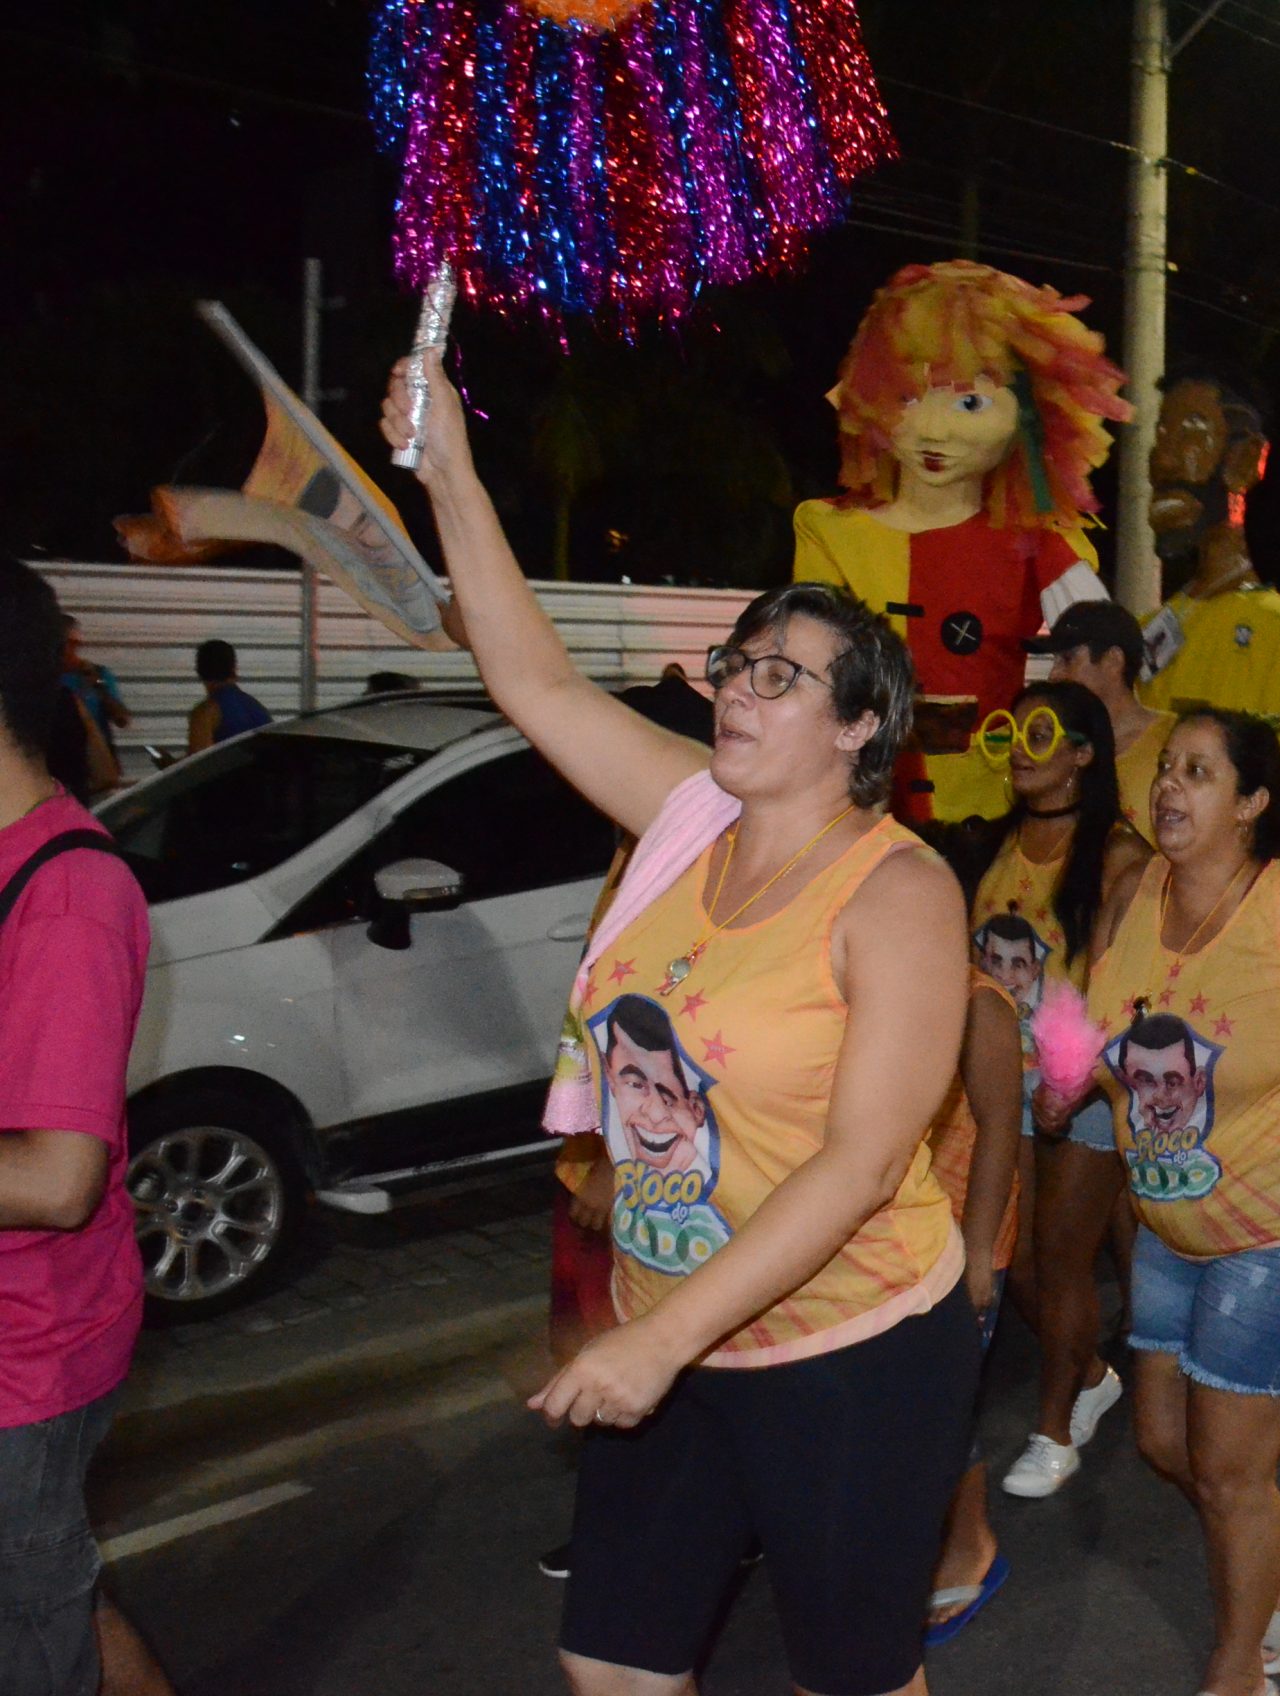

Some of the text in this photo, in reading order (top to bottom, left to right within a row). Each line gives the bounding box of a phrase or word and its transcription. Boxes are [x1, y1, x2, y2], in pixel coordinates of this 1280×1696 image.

[1173, 1149, 1187, 1164] do
[614, 1160, 703, 1210] Bloco
[671, 1201, 689, 1222] do
